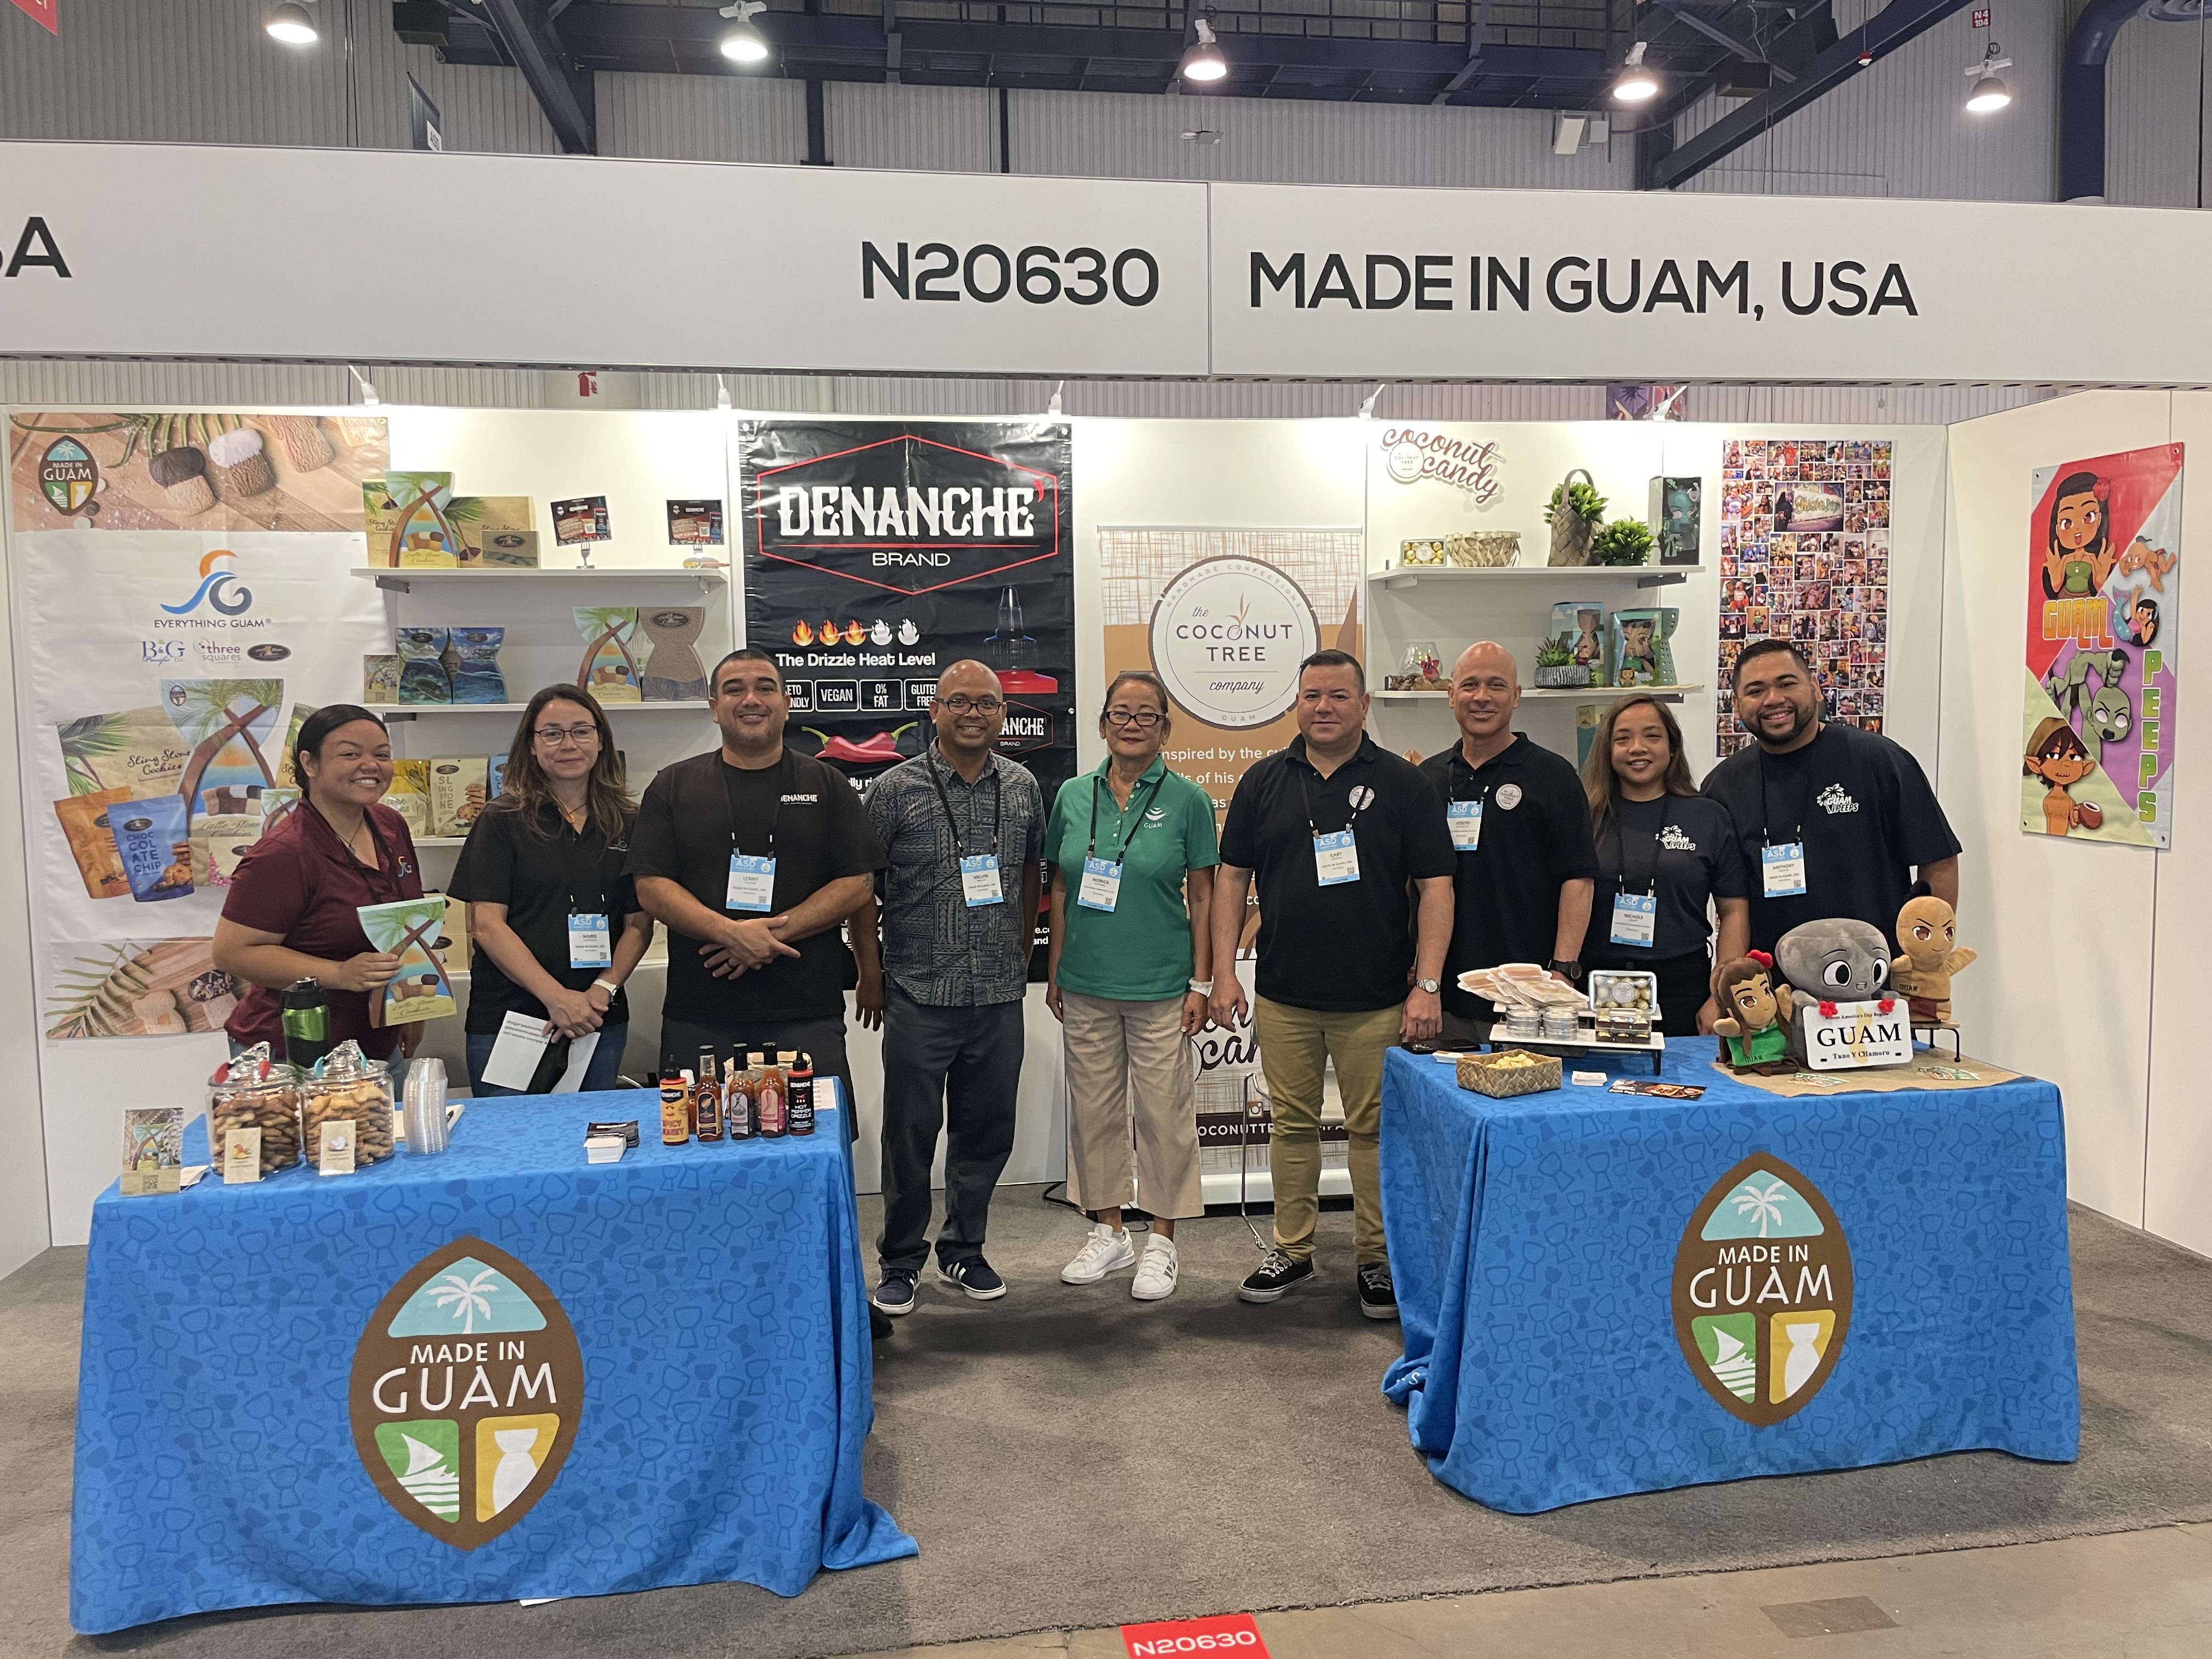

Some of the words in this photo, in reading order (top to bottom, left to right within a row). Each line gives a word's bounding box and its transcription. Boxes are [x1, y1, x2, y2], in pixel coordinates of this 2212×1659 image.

[1974, 18, 1989, 27] 104
[0, 217, 73, 278] A
[861, 241, 1159, 307] N20630
[1250, 251, 1453, 311] MADE
[1471, 256, 1529, 312] IN
[1545, 256, 1764, 322] GUAM,
[1782, 261, 1918, 317] USA
[1382, 428, 1503, 470] coconut
[43, 468, 92, 481] GUAM
[1421, 456, 1498, 504] candy
[872, 552, 951, 567] BRAND
[1166, 566, 1218, 608] HANDMADE
[1227, 564, 1301, 608] CONFECTIONS
[1192, 606, 1209, 617] the
[154, 619, 227, 628] EVERYTHING
[2043, 596, 2114, 651] GUAM
[1176, 624, 1293, 641] COCONUT
[207, 641, 240, 653] three
[201, 653, 241, 663] squares
[775, 653, 804, 667] The
[808, 653, 856, 667] Drizzle
[859, 653, 895, 666] Heat
[899, 652, 936, 666] Level
[1206, 646, 1266, 662] TREE
[875, 683, 887, 695] 0%
[1209, 681, 1265, 695] company
[821, 689, 853, 702] VEGAN
[873, 695, 889, 708] FAT
[2138, 648, 2163, 824] PEEPS
[127, 755, 159, 768] Sling
[161, 749, 191, 761] Stone
[1162, 748, 1214, 763] nspired
[1218, 747, 1236, 762] by
[1240, 747, 1262, 759] the
[143, 762, 183, 775] Cookies
[438, 776, 453, 785] SL
[1197, 772, 1210, 783] of
[1215, 772, 1235, 783] his
[439, 800, 454, 810] NE
[1827, 795, 1852, 805] GUAM
[1836, 802, 1859, 812] PEEPS
[126, 831, 155, 842] CHOC
[1319, 836, 1337, 847] ASD
[128, 840, 157, 851] COL
[1674, 842, 1696, 851] PEEPS
[132, 849, 159, 864] ATE
[1767, 849, 1785, 858] ASD
[133, 861, 161, 873] CHIP
[736, 859, 756, 867] ASD
[966, 860, 982, 868] ASD
[1088, 862, 1105, 871] ASD
[1899, 984, 1918, 992] GUAM
[1816, 1023, 1902, 1047] GUAM
[1718, 1245, 1780, 1265] MADE
[1788, 1244, 1809, 1262] IN
[1689, 1264, 1833, 1308] GUAM
[410, 1342, 488, 1364] MADE
[499, 1340, 525, 1361] IN
[373, 1362, 557, 1414] GUAM
[1132, 1630, 1257, 1656] N20630
